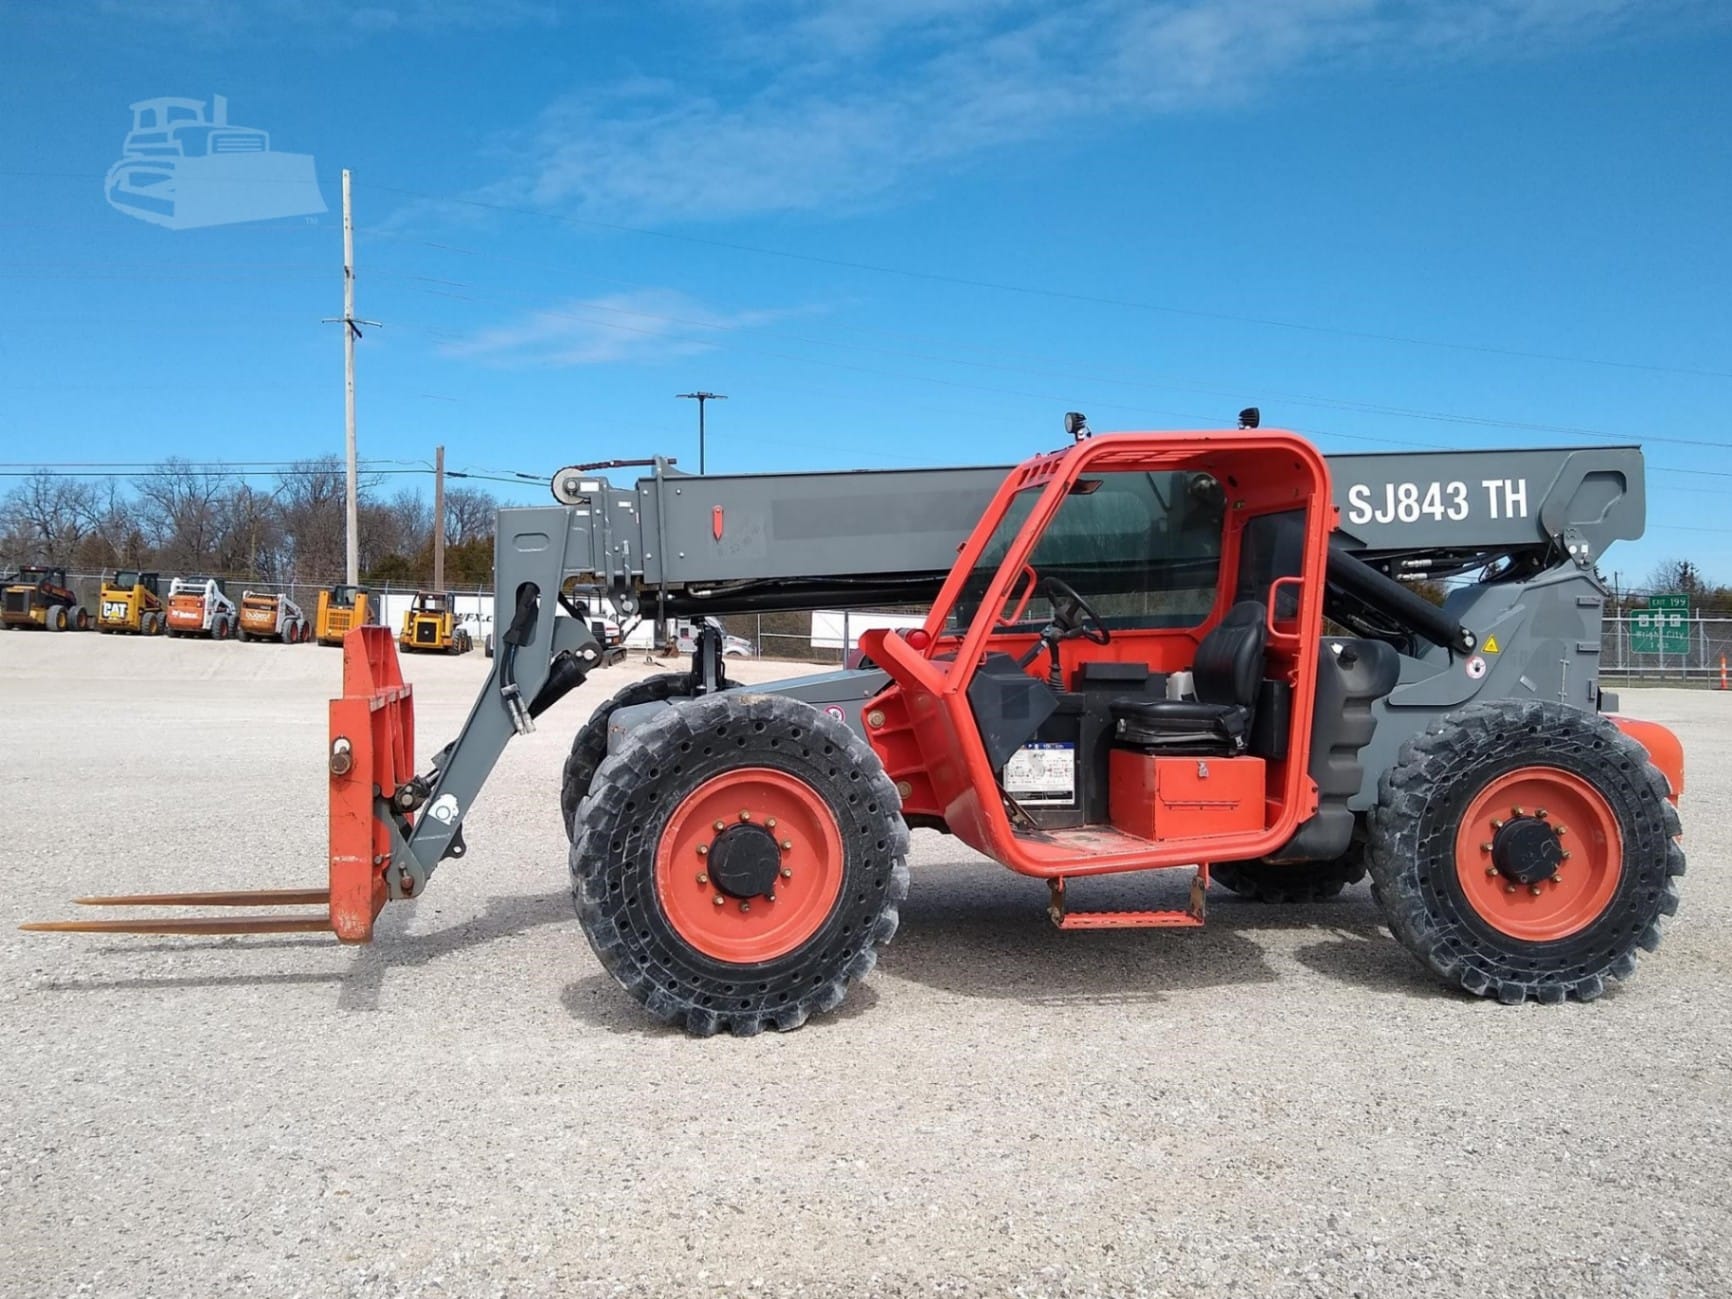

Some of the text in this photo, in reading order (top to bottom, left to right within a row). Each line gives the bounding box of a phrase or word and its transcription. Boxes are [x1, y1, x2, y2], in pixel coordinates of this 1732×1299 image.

[1348, 479, 1528, 525] SJ843 TH
[103, 602, 127, 619] CAT
[1670, 598, 1687, 607] 199
